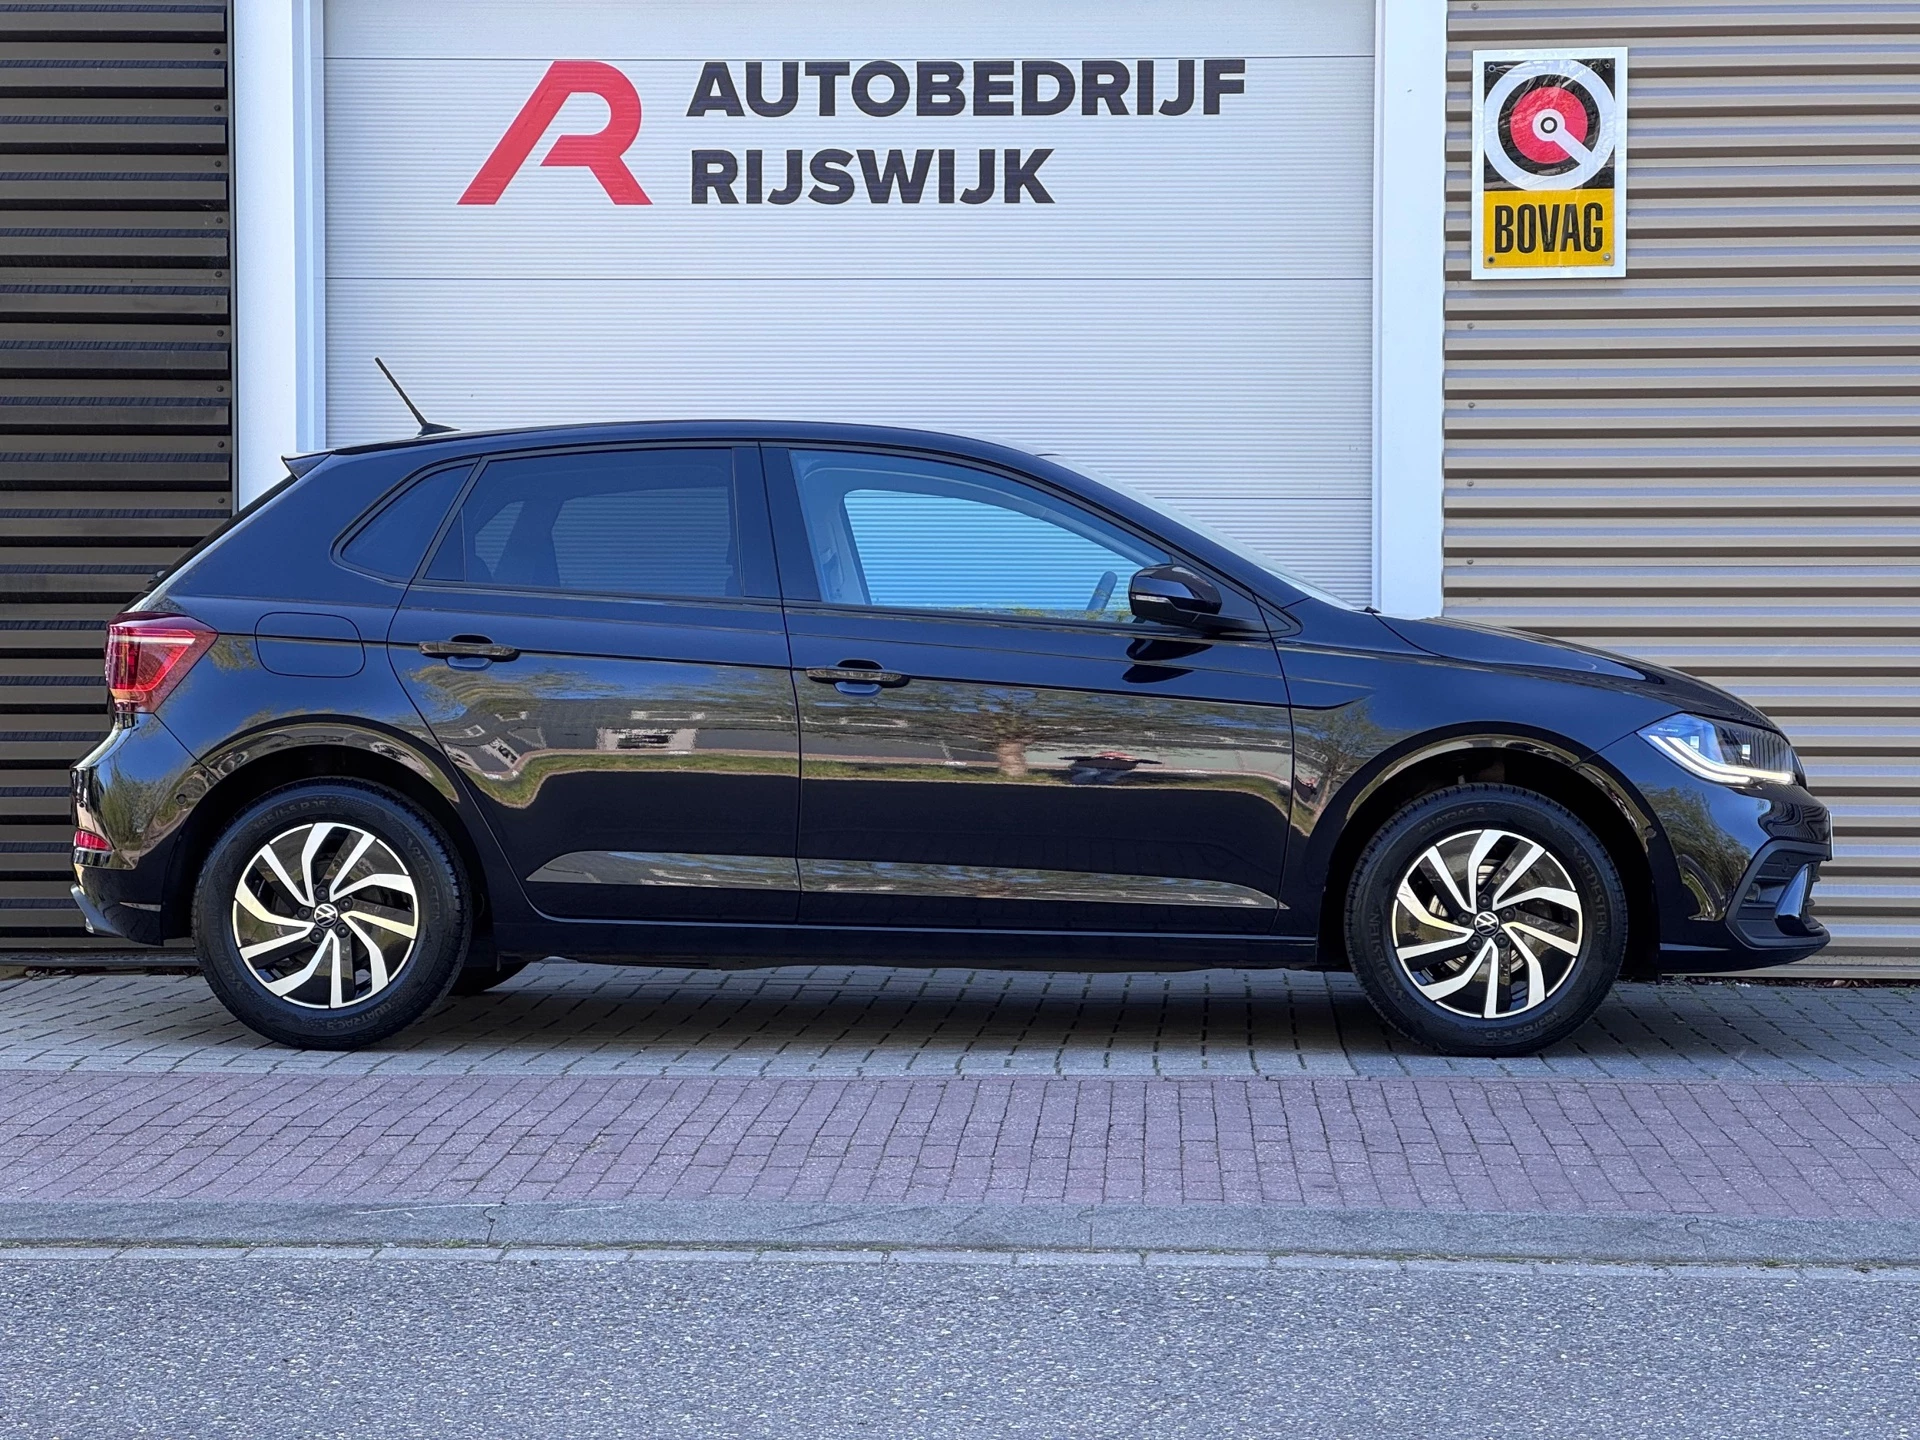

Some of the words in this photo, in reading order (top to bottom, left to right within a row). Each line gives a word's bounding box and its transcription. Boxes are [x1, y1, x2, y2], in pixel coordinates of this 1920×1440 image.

[685, 59, 1246, 118] AUTOBEDRIJF
[691, 148, 1056, 205] RIJSWIJK
[1494, 202, 1604, 254] BOVAG
